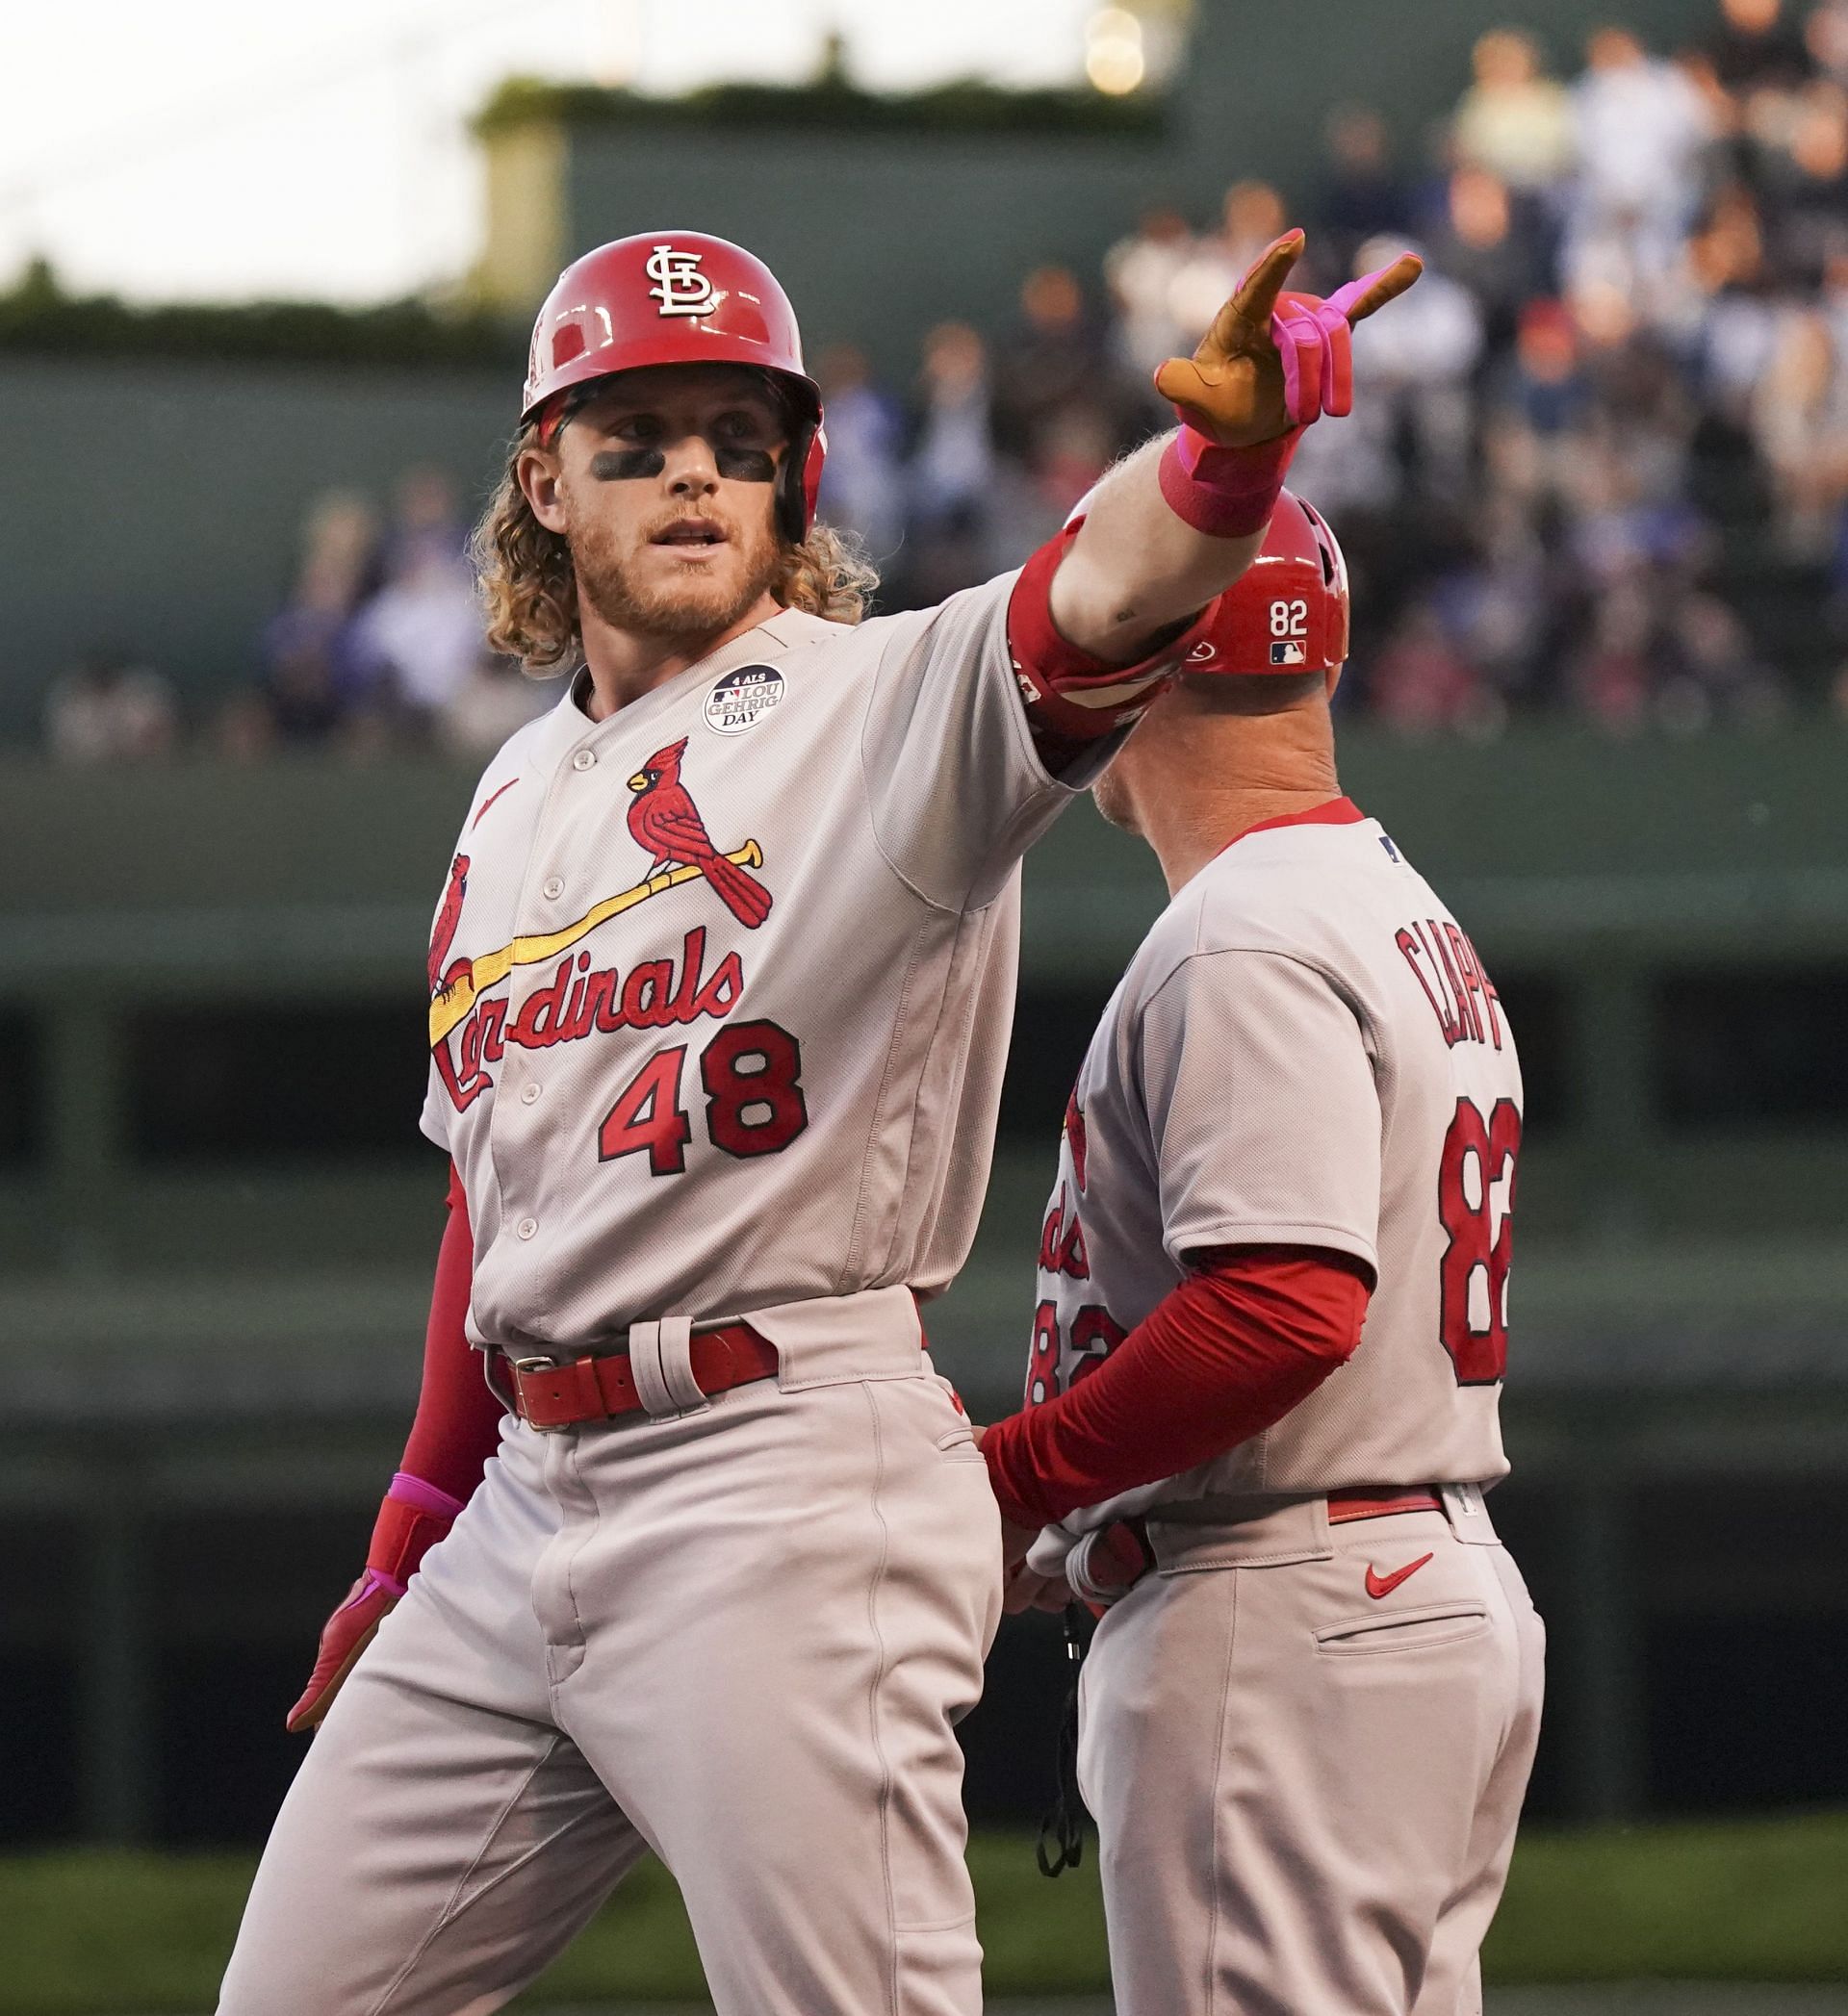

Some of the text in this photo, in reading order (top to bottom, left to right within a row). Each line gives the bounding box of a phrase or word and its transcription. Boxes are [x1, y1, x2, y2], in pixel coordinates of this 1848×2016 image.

[1270, 599, 1308, 637] 82
[742, 673, 766, 685] ALS
[741, 682, 780, 700] LOU
[707, 696, 779, 716] GEHRIG
[722, 710, 760, 727] DAY
[598, 1017, 809, 1177] 48
[1437, 1095, 1523, 1388] 82
